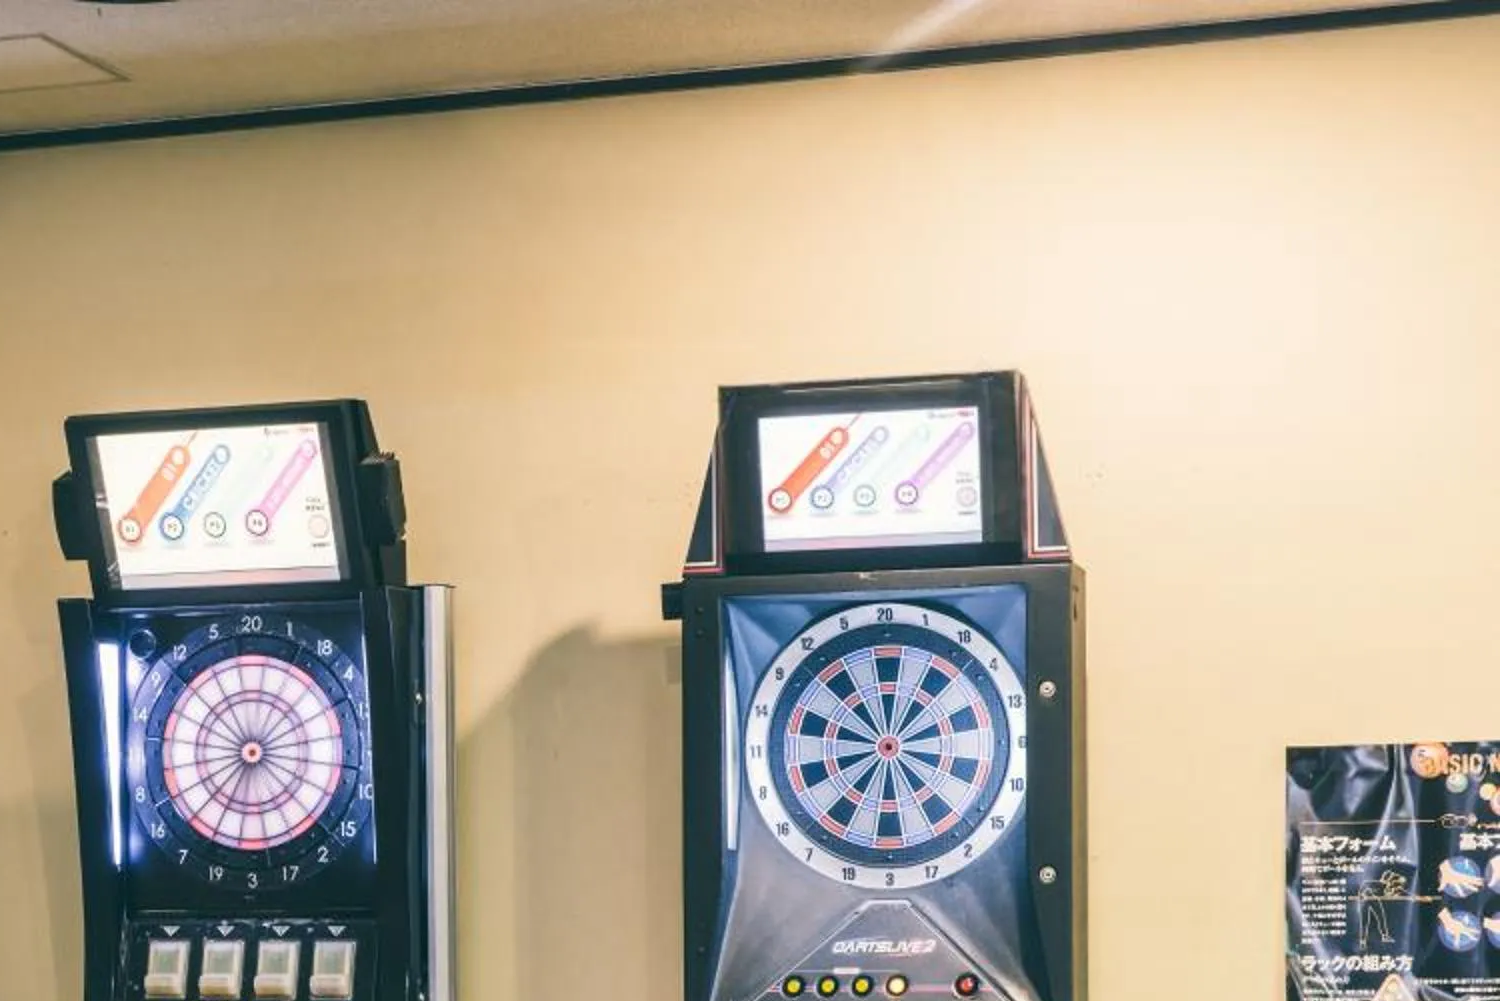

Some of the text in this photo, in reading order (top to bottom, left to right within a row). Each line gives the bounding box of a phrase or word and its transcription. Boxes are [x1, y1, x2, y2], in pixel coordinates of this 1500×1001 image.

[877, 609, 893, 621] 20
[923, 615, 929, 626] 1
[241, 616, 262, 632] 20
[287, 622, 293, 635] 1
[840, 618, 849, 630] 5
[209, 625, 219, 639] 5
[957, 630, 971, 643] 18
[317, 640, 332, 654] 18
[801, 638, 814, 650] 12
[173, 644, 187, 660] 12
[989, 658, 998, 670] 4
[343, 665, 353, 679] 4
[775, 668, 785, 680] 9
[152, 672, 160, 686] 9
[1008, 696, 1021, 707] 13
[756, 705, 768, 717] 14
[1010, 779, 1024, 791] 10
[135, 786, 145, 802] 8
[759, 787, 768, 799] 8
[340, 822, 356, 836] 15
[990, 816, 1005, 829] 15
[150, 823, 165, 838] 16
[776, 823, 789, 836] 16
[964, 844, 973, 857] 2
[1301, 835, 1396, 853] 基本フォーム
[180, 850, 189, 864] 7
[317, 847, 329, 863] 2
[805, 848, 814, 861] 7
[209, 866, 224, 881] 19
[283, 866, 299, 880] 17
[842, 868, 856, 880] 19
[925, 866, 939, 877] 17
[248, 873, 258, 888] 3
[886, 873, 894, 885] 3
[1301, 954, 1414, 972] ラックの組み方
